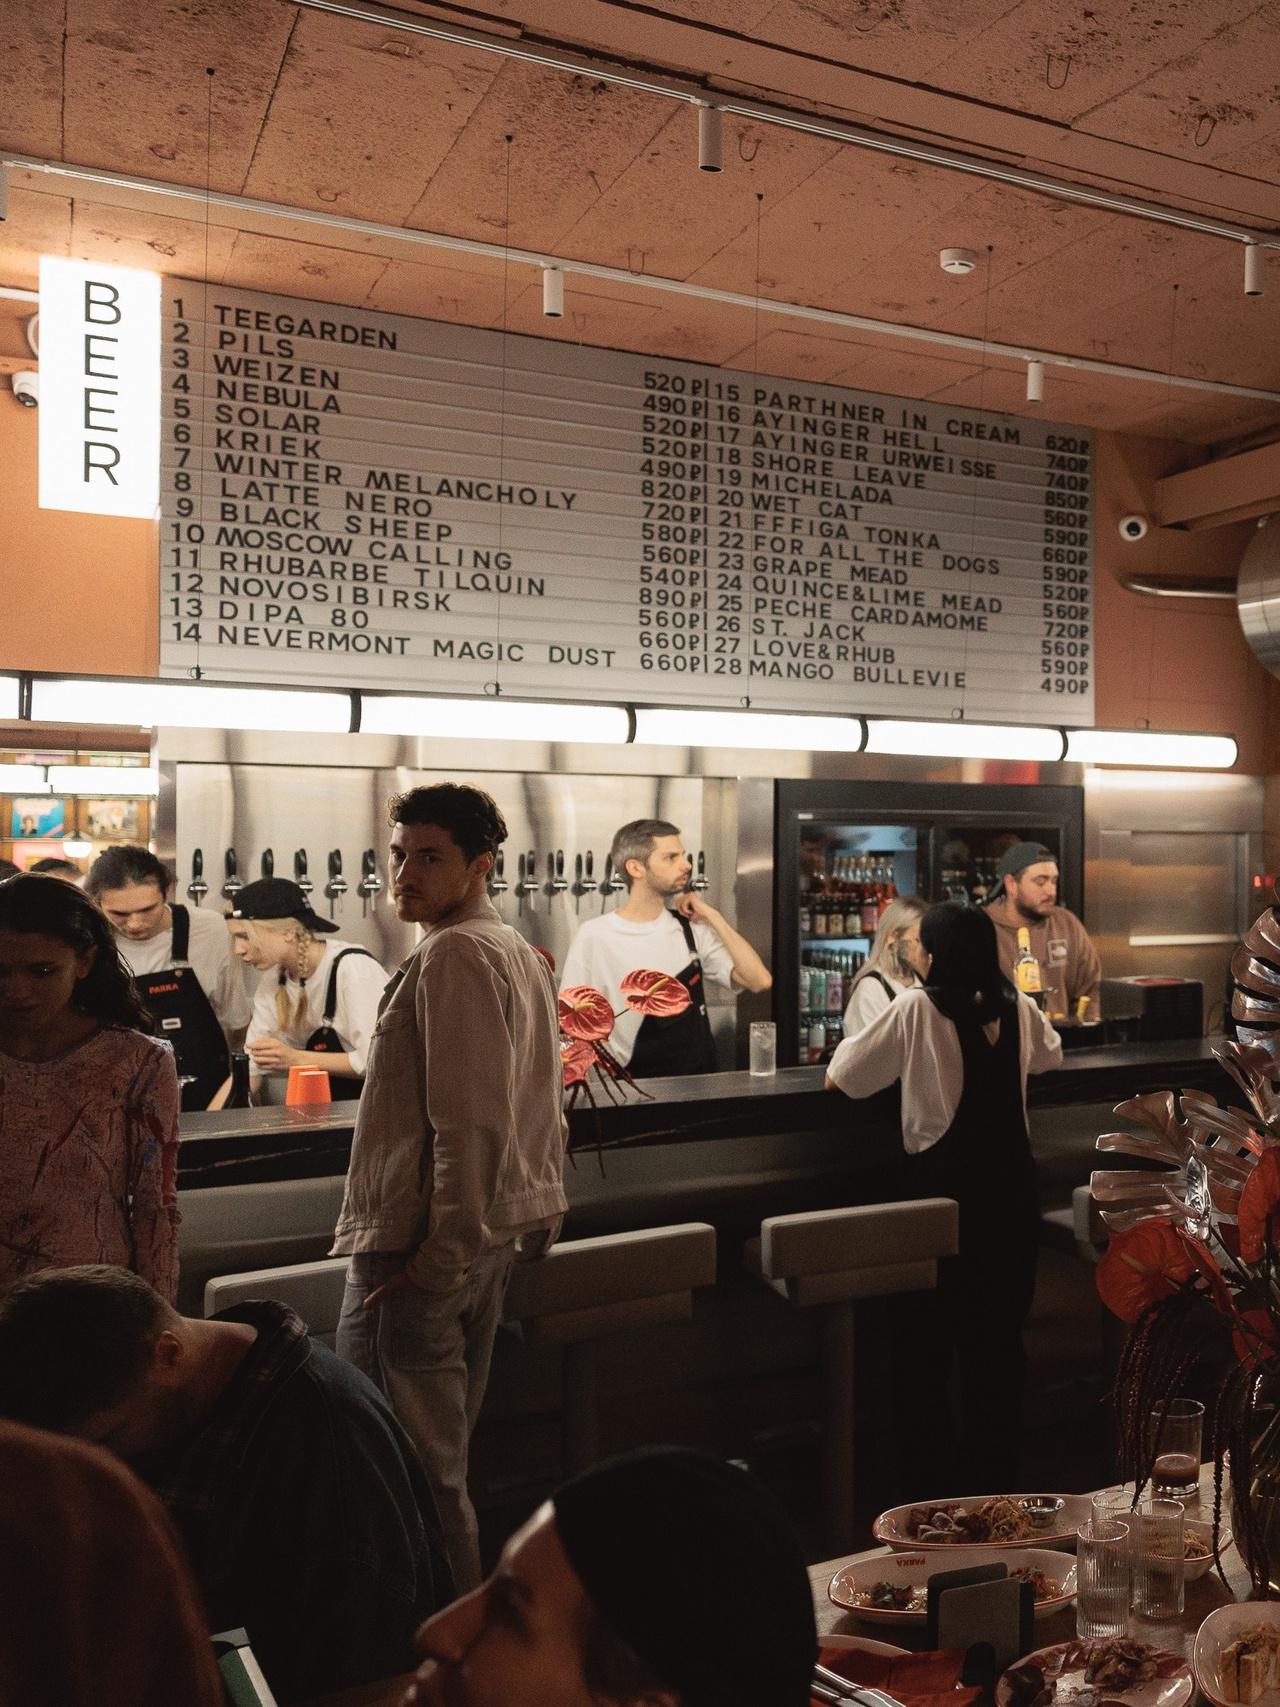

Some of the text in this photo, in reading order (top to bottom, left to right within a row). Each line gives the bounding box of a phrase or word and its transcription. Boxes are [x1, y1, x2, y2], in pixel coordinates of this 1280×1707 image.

[174, 299, 183, 318] 1
[214, 305, 396, 350] TEEGARDEN
[174, 323, 189, 343] 2
[219, 331, 294, 359] PILS
[84, 281, 122, 486] BEER
[173, 349, 189, 368] 3
[214, 355, 339, 390] WEIZEN
[172, 374, 190, 393] 4
[217, 380, 341, 414] NEBULA
[175, 398, 190, 418] 5
[216, 404, 320, 435] SOLAR
[716, 384, 739, 402] 15
[754, 389, 884, 424] PARTHNER
[946, 419, 1020, 444] CREAM
[717, 405, 740, 423] 16
[752, 410, 869, 442] AYINGER
[174, 424, 190, 443] 6
[217, 429, 320, 459] KRIEK
[718, 426, 739, 443] 17
[752, 431, 868, 462] AYINGER
[175, 448, 190, 467] 7
[215, 453, 341, 485] WINTER
[365, 471, 576, 510] MELANCHOLY
[717, 447, 741, 465] 18
[753, 452, 833, 477] SHORE
[854, 465, 925, 489] LEAVE
[717, 468, 741, 486] 19
[752, 472, 893, 505] MICHELADA
[175, 472, 191, 492] 8
[222, 478, 319, 506] LATTE
[346, 491, 432, 517] NERO
[717, 489, 744, 507] 20
[751, 493, 800, 513] WET
[819, 501, 862, 521] CAT
[177, 498, 193, 517] 9
[221, 503, 320, 531] BLACK
[345, 515, 452, 542] SHEEP
[719, 510, 741, 528] 21
[864, 527, 940, 549] TONKA
[171, 523, 204, 544] 10
[215, 527, 352, 557] MOSCOW
[369, 541, 511, 570] CALLING
[718, 532, 743, 549] 22
[755, 535, 803, 555] FOR
[819, 542, 864, 561] ALL
[878, 548, 922, 567] THE
[943, 555, 999, 574] DOGS
[172, 548, 198, 568] 11
[220, 552, 387, 584] RHUBARBE
[414, 568, 544, 596] TILQUIN
[718, 552, 743, 570] 23
[754, 556, 831, 578] GRAPE
[851, 566, 907, 585] MEAD
[172, 573, 203, 594] 12
[220, 576, 450, 611] NOVOSIBIRSK
[717, 574, 742, 591] 24
[942, 594, 1002, 613] MEAD
[171, 597, 202, 618] 13
[219, 601, 303, 624] DIPA
[331, 609, 368, 628] 80
[716, 616, 740, 632] 26
[804, 622, 864, 641] JACK
[718, 595, 742, 612] 25
[755, 598, 831, 619] PECHE
[851, 606, 987, 631] CARDAMOME
[173, 622, 201, 643] 14
[219, 625, 410, 655] NEVERMONT
[434, 640, 523, 662] MAGIC
[549, 646, 615, 667] DUST
[715, 637, 740, 653] 27
[715, 658, 741, 674] 28
[750, 660, 833, 680] MANGO
[854, 667, 965, 688] BULLEVIE
